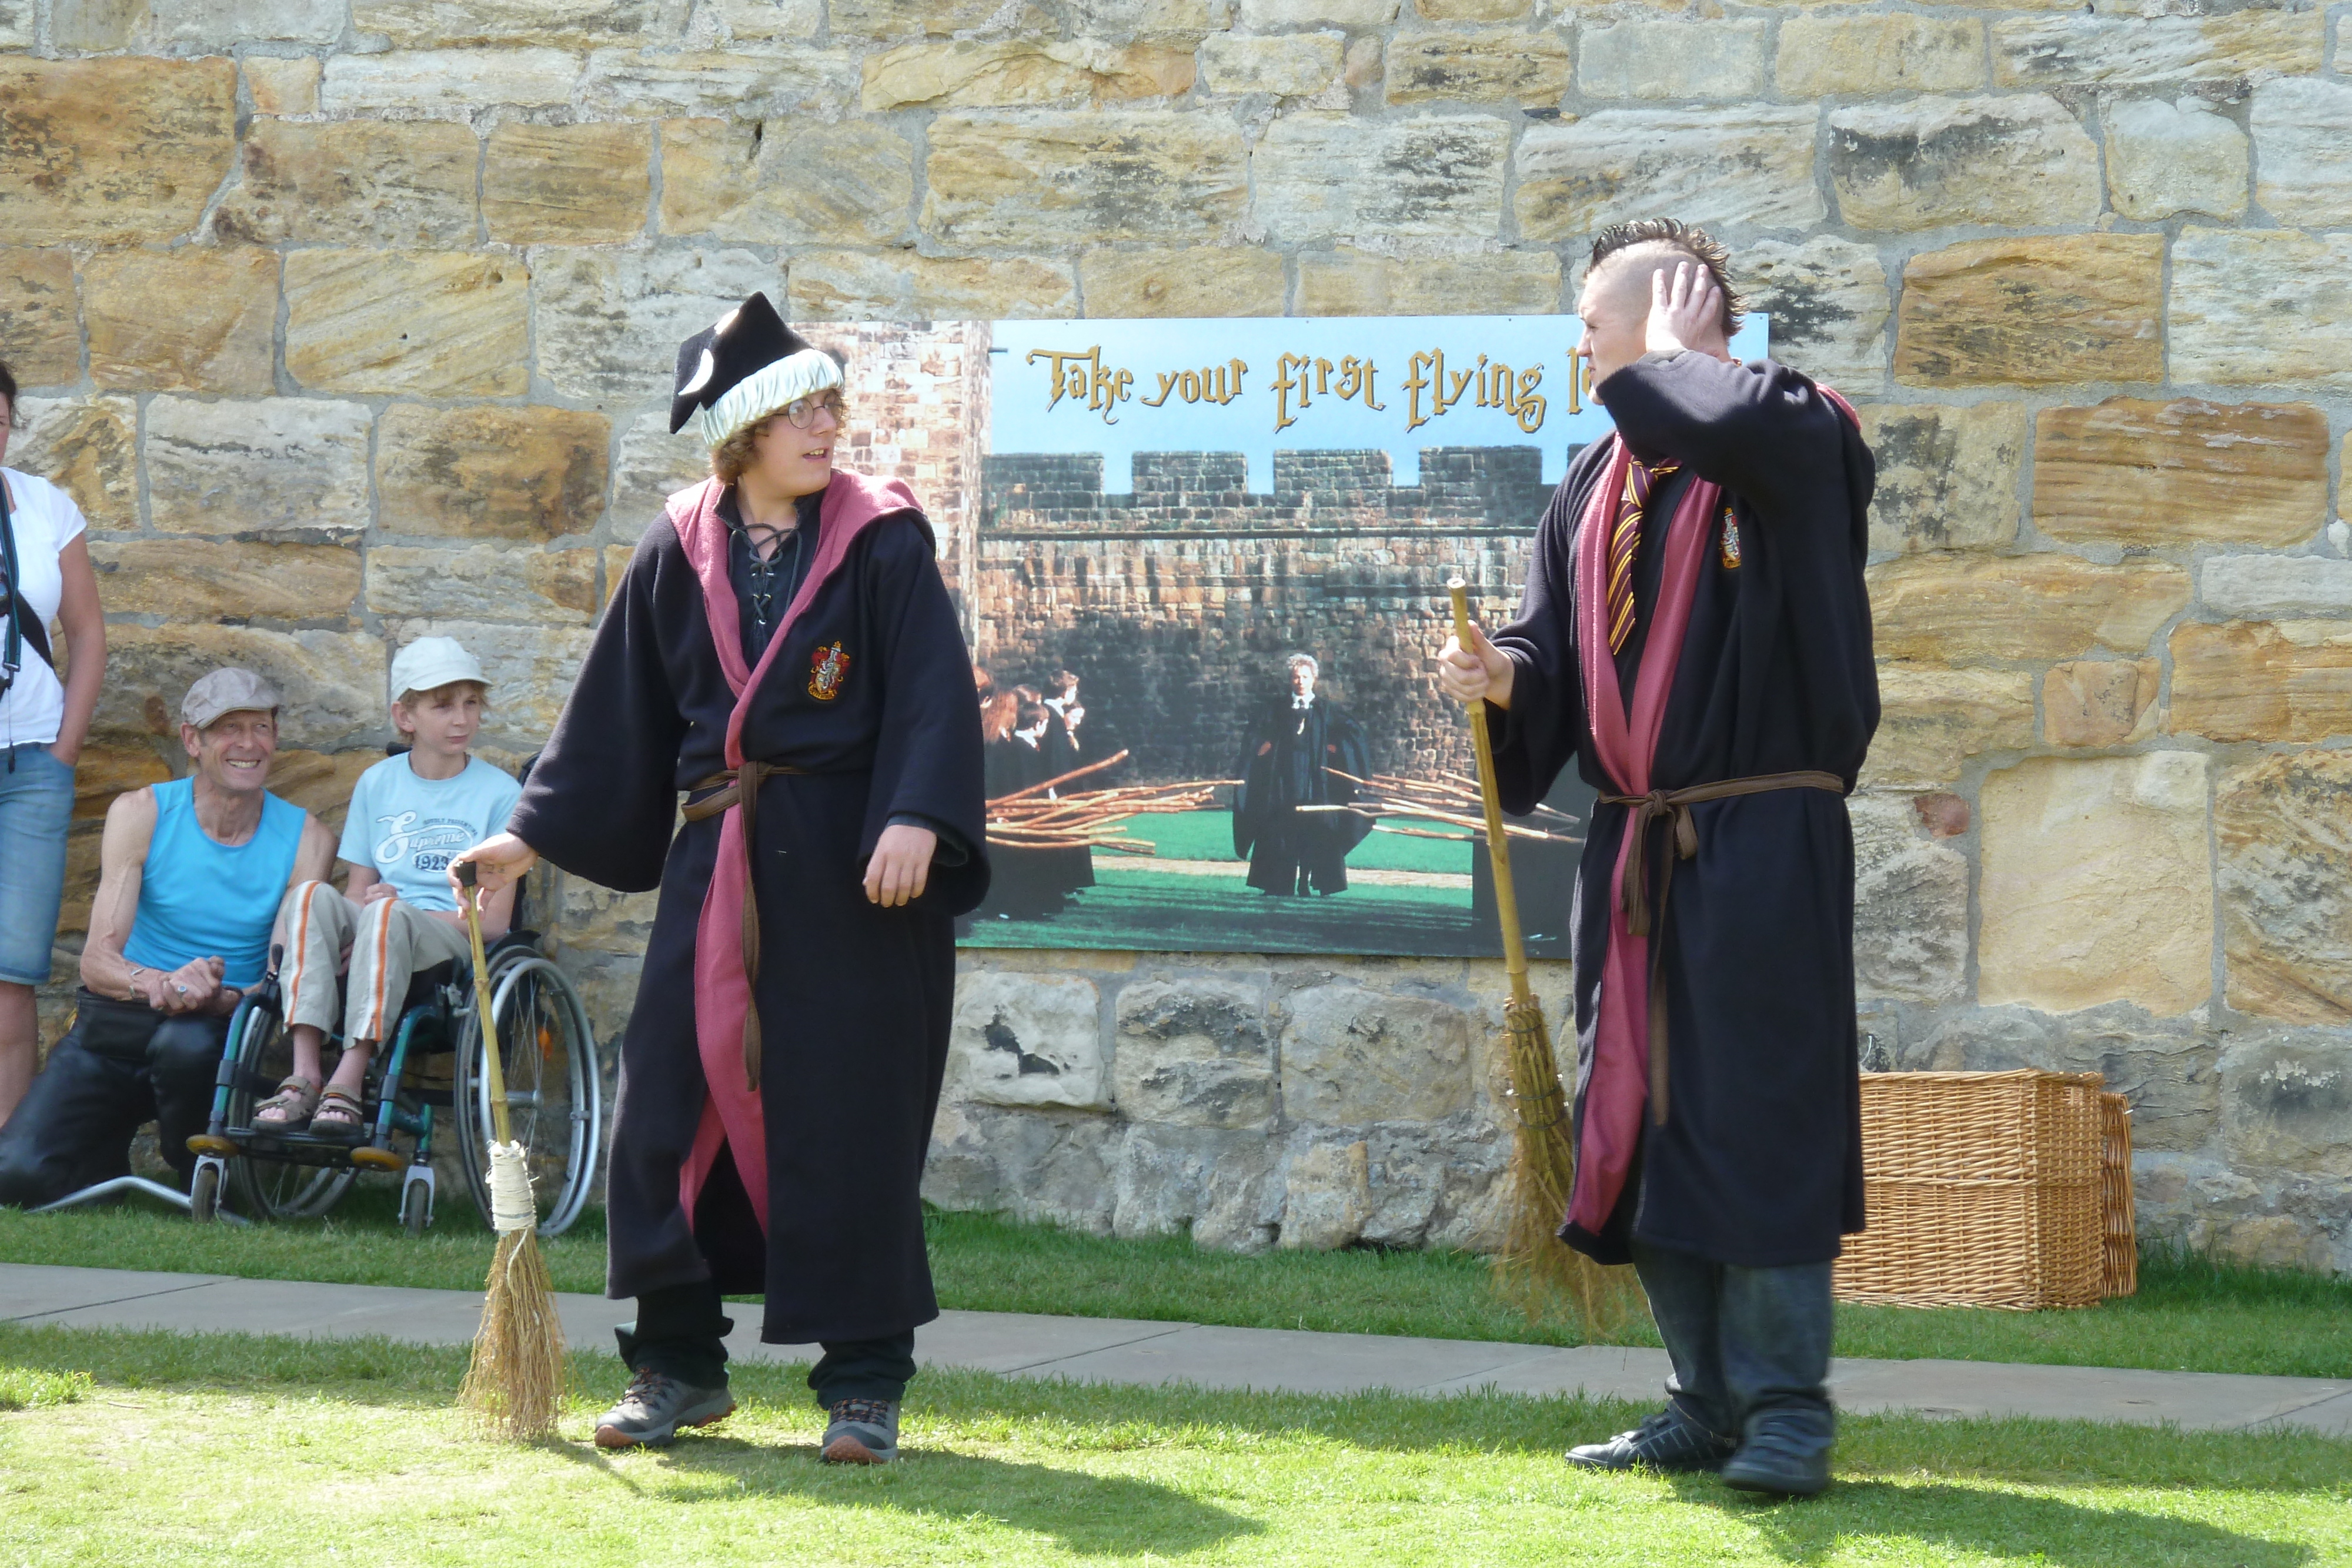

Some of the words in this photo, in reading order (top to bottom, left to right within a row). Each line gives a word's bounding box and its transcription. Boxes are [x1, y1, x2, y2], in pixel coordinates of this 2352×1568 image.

[1025, 344, 1134, 424] Take
[1140, 357, 1248, 407] your
[1268, 352, 1387, 434] first
[1401, 347, 1547, 433] flying
[416, 855, 449, 870] 1923
